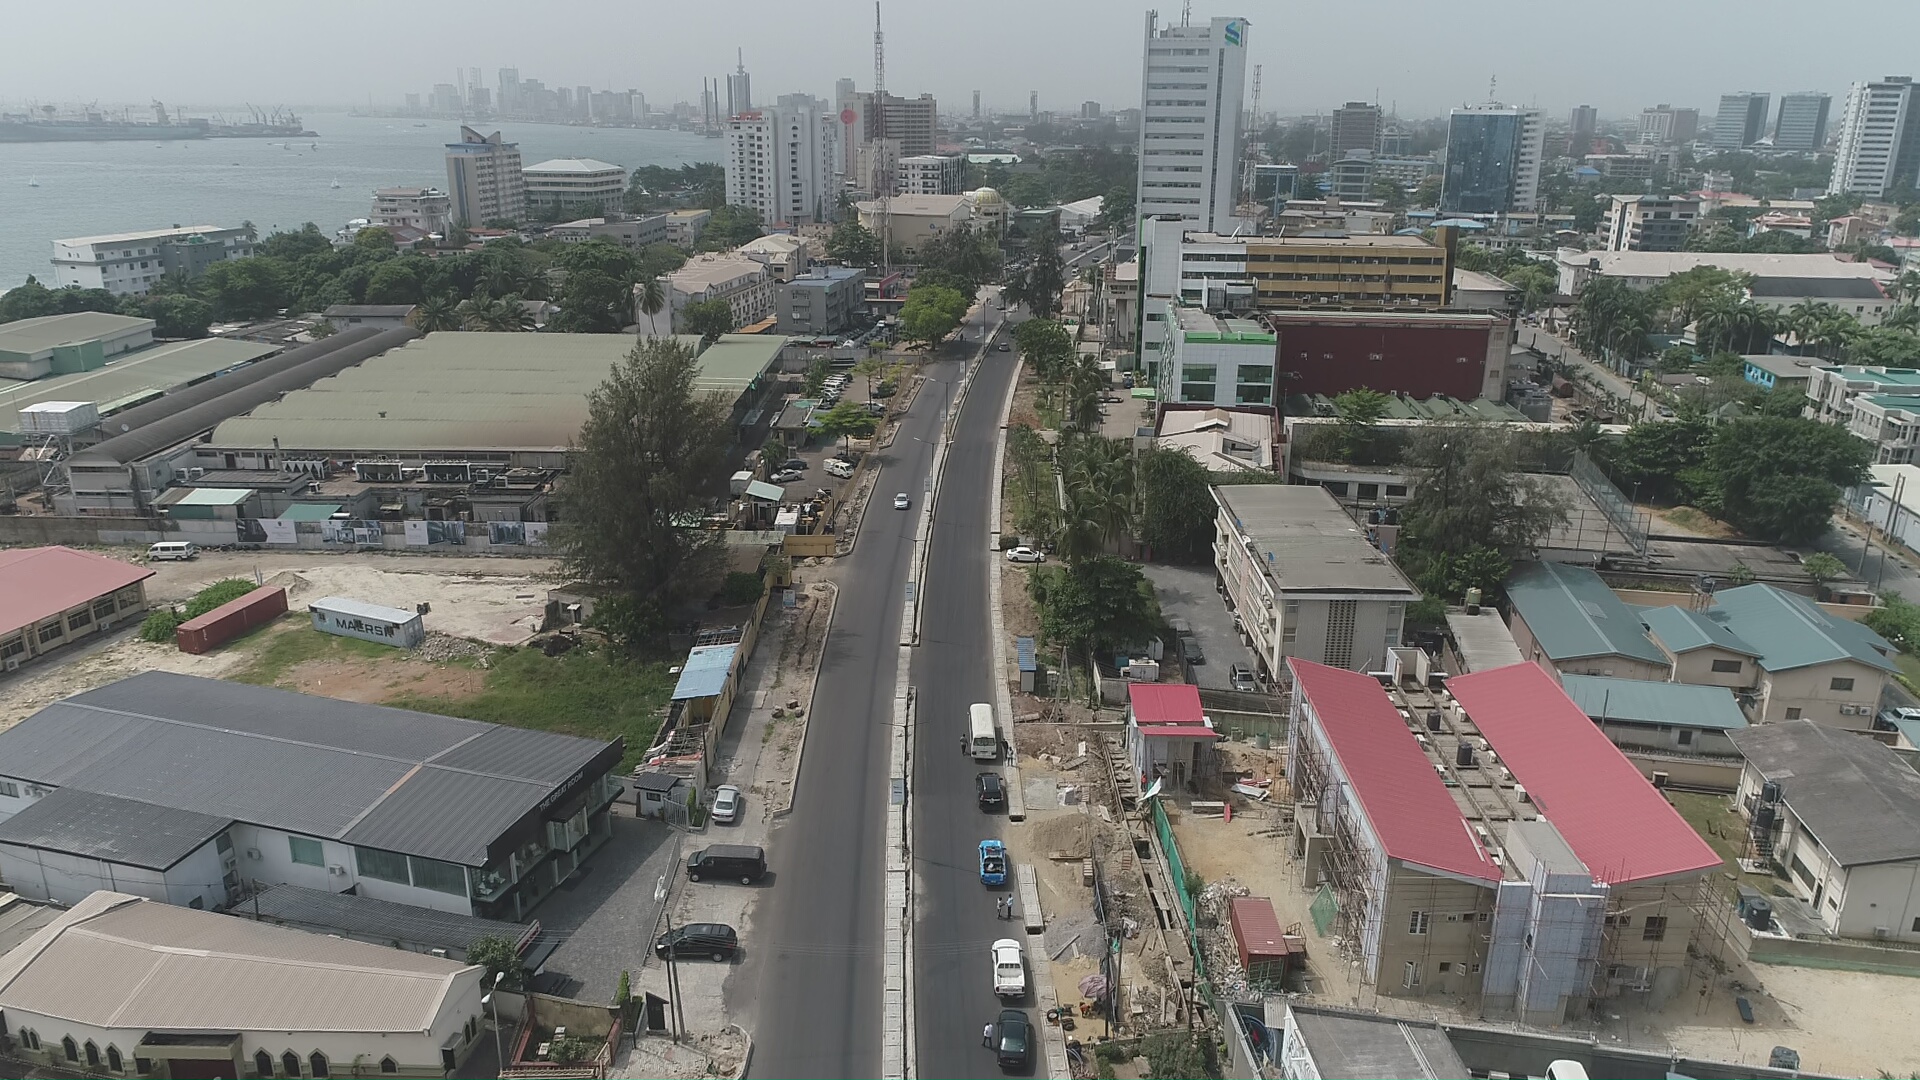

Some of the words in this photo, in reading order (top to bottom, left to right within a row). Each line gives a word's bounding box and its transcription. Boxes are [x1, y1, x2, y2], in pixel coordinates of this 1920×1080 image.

[539, 798, 550, 811] THE
[551, 784, 567, 802] GREAT
[567, 771, 584, 789] ROOM
